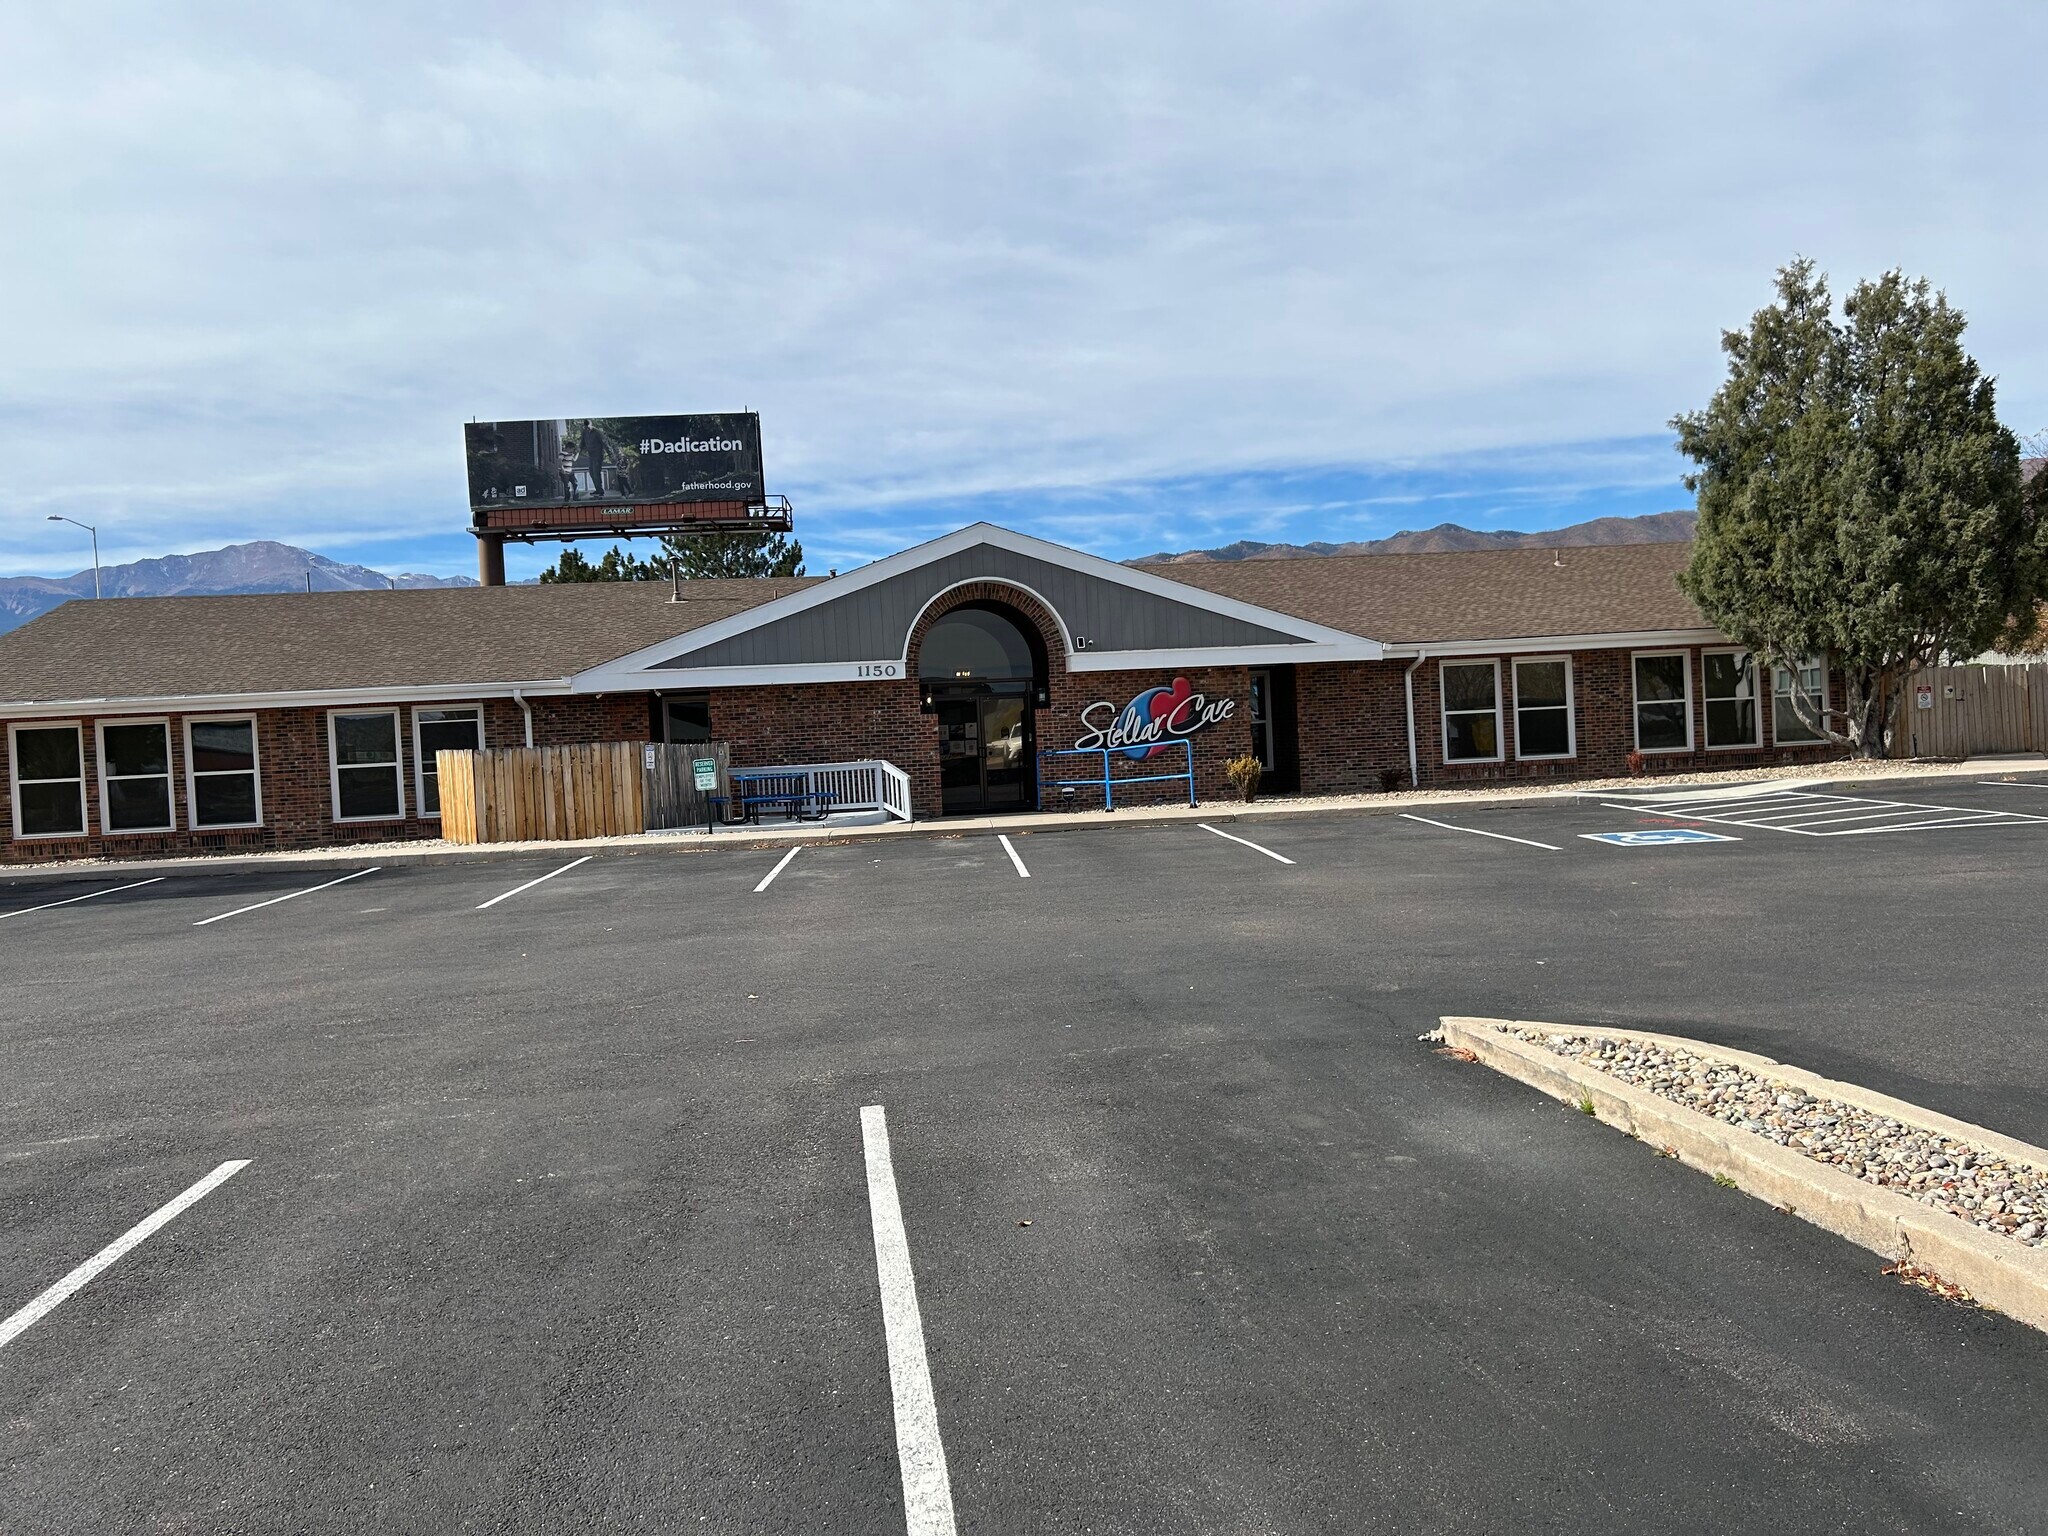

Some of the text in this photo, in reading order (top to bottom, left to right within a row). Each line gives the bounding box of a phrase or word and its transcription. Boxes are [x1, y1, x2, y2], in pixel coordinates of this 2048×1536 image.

[640, 436, 743, 454] #Dadication
[681, 481, 752, 491] fatherhood.gov
[858, 665, 896, 677] 1150
[1074, 694, 1235, 750] Stellar Care
